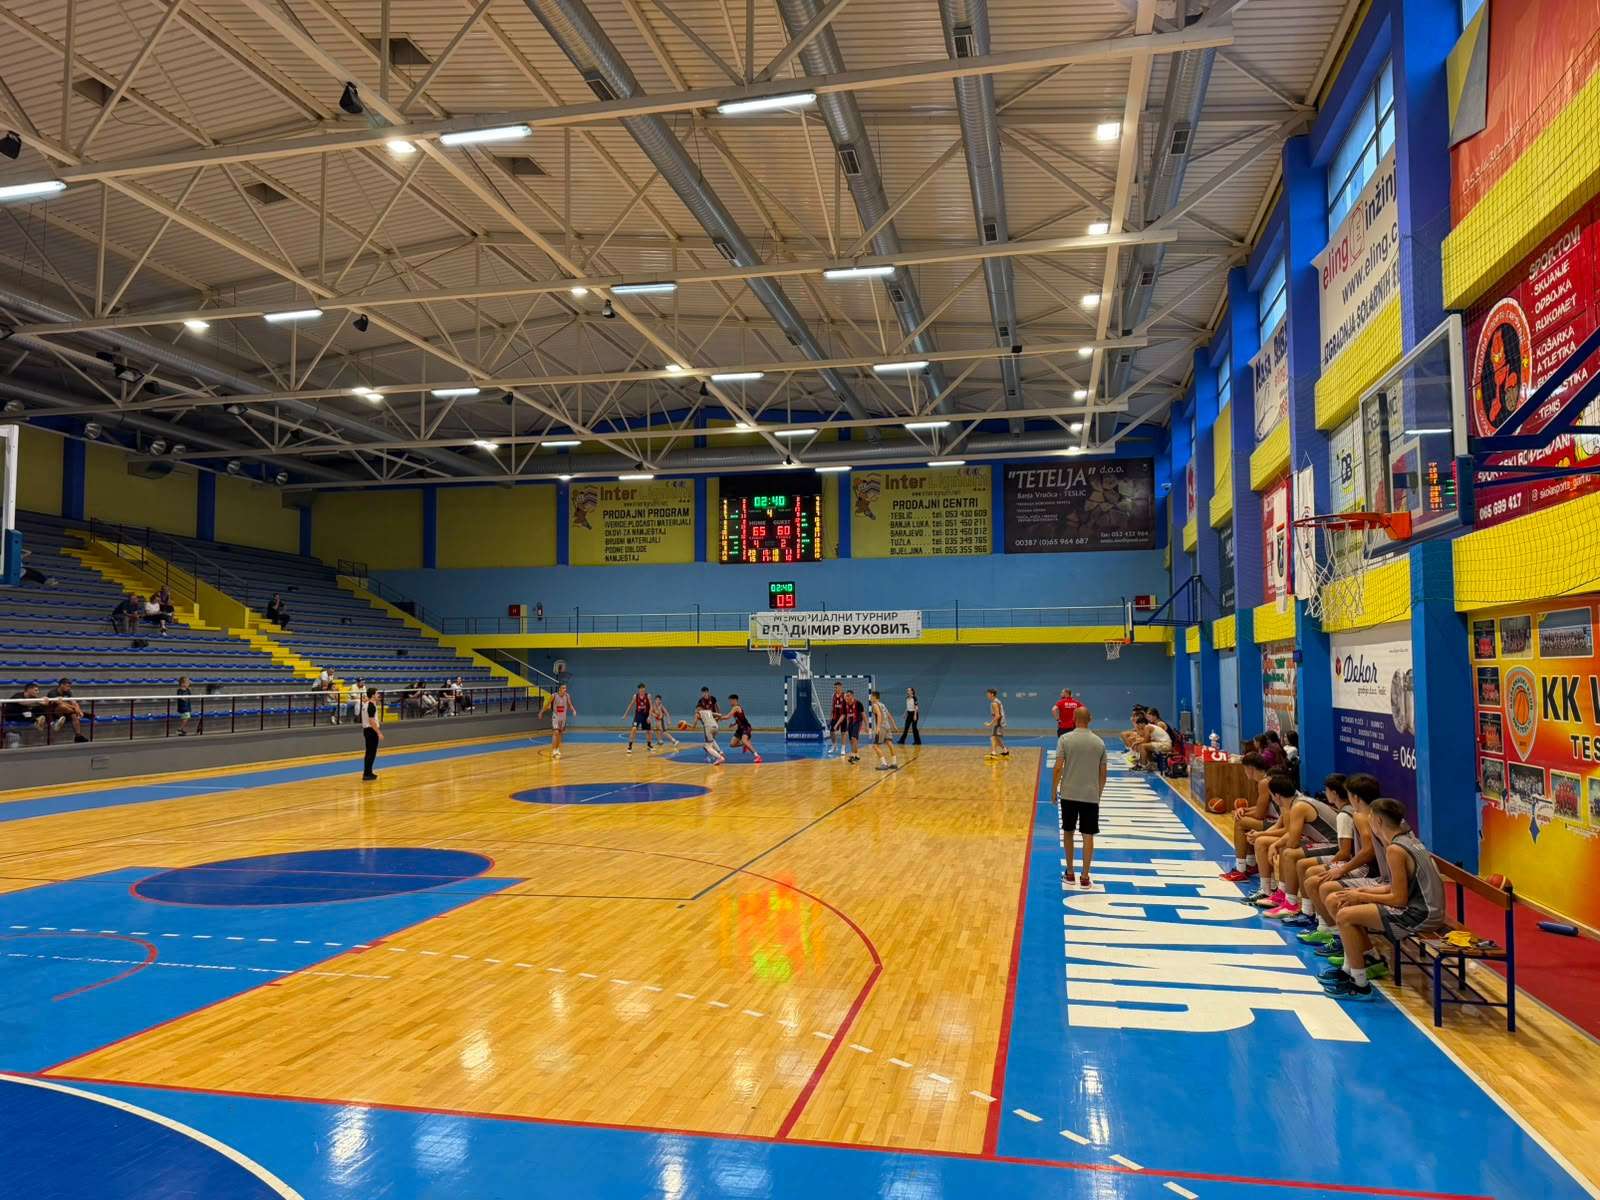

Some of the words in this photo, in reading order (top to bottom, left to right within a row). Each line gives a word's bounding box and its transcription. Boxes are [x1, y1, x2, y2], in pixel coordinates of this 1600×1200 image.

[1529, 224, 1581, 280] SPORTOVI
[1323, 234, 1349, 291] eling
[1535, 278, 1573, 315] ODBOJKA
[1535, 292, 1577, 331] RUKOMET
[1536, 325, 1575, 359] KOŠARKA
[1537, 341, 1577, 374] ATLETIKA
[1539, 399, 1560, 419] TENIS
[1100, 465, 1124, 474] d.o.o.
[754, 496, 785, 507] 02:40
[893, 499, 940, 510] PRODAJNI
[943, 498, 978, 509] CENTRI
[1508, 492, 1522, 511] 417
[602, 509, 646, 520] PRODAJNI
[648, 507, 690, 518] PROGRAM
[767, 509, 773, 518] 4
[752, 526, 766, 536] 65
[777, 525, 791, 536] 60
[890, 538, 912, 546] TUZLA
[771, 584, 793, 593] 02:40
[777, 594, 793, 607] 09
[855, 612, 898, 622] ТУРНИР
[843, 622, 910, 636] ВУКОВИЋ
[1344, 654, 1378, 684] Dekor
[1541, 675, 1583, 724] KK
